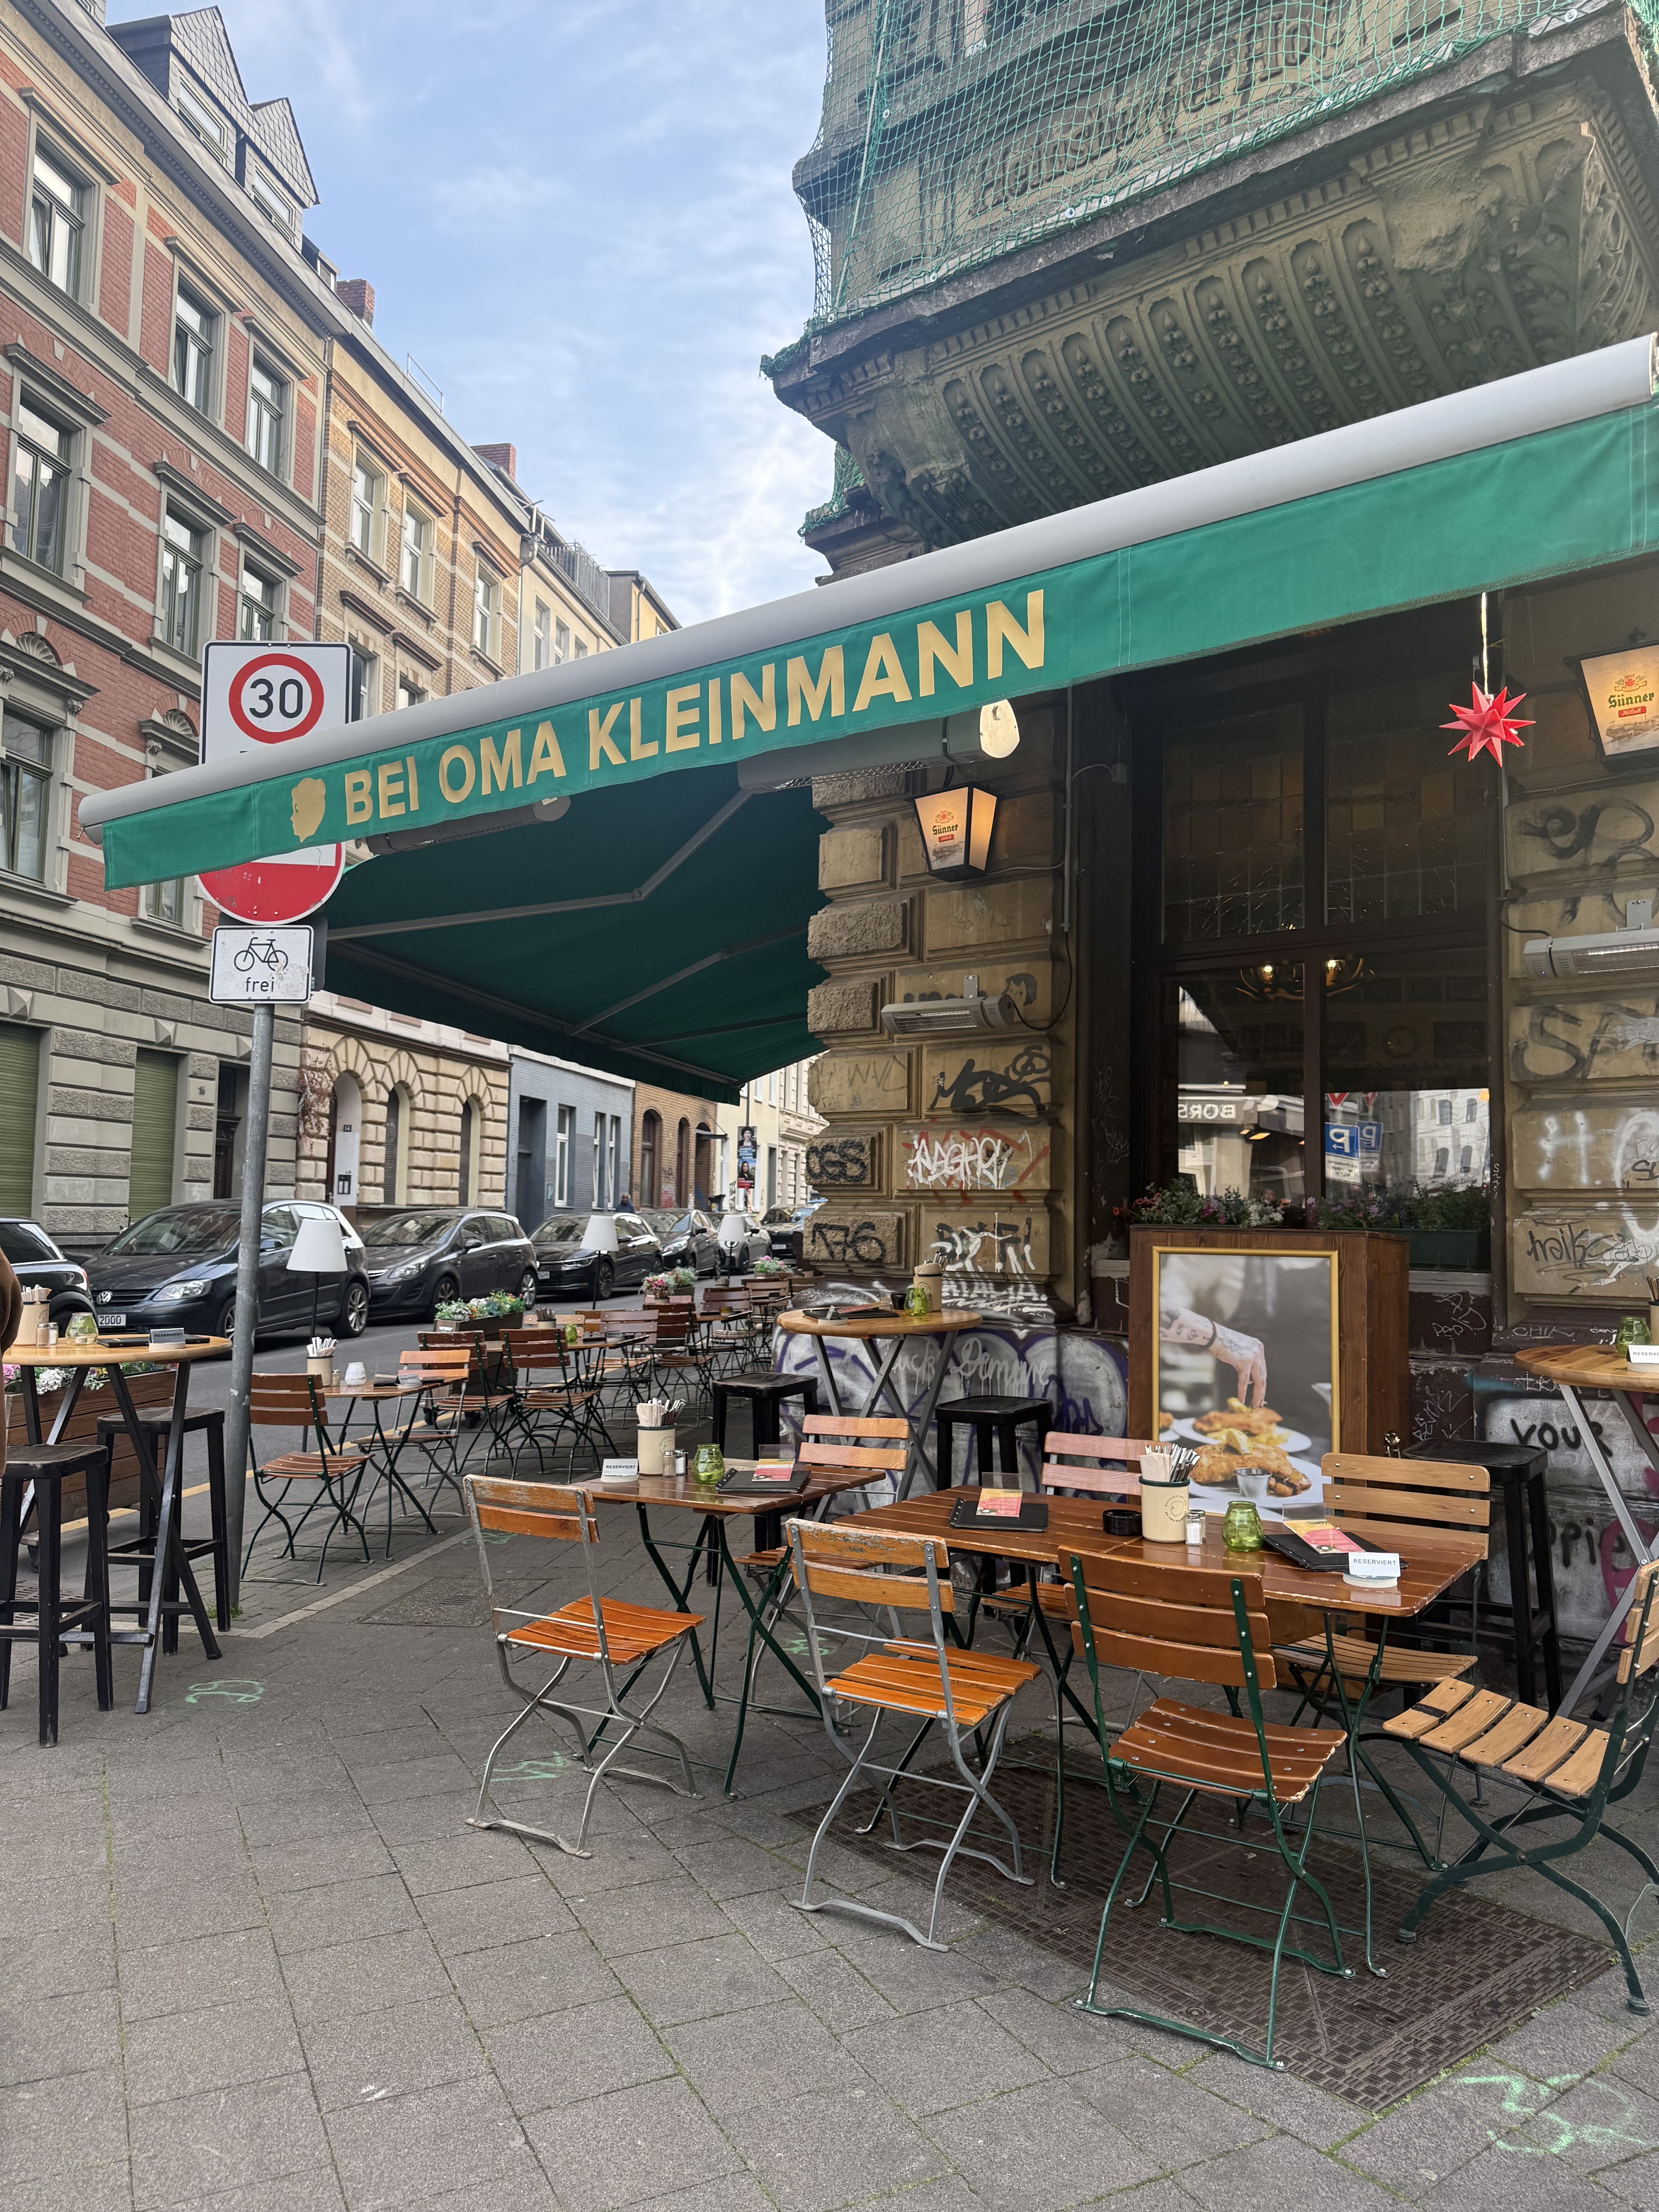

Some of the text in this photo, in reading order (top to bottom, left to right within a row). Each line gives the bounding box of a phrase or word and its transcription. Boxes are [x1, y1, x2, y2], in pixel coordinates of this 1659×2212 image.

[249, 678, 304, 718] 30
[1608, 692, 1654, 708] Sünner
[344, 590, 1044, 825] BEI OMA KLEINMANN
[932, 824, 959, 835] Sünner
[245, 977, 275, 992] frei
[198, 1085, 206, 1095] 16
[100, 1315, 121, 1324] 2000
